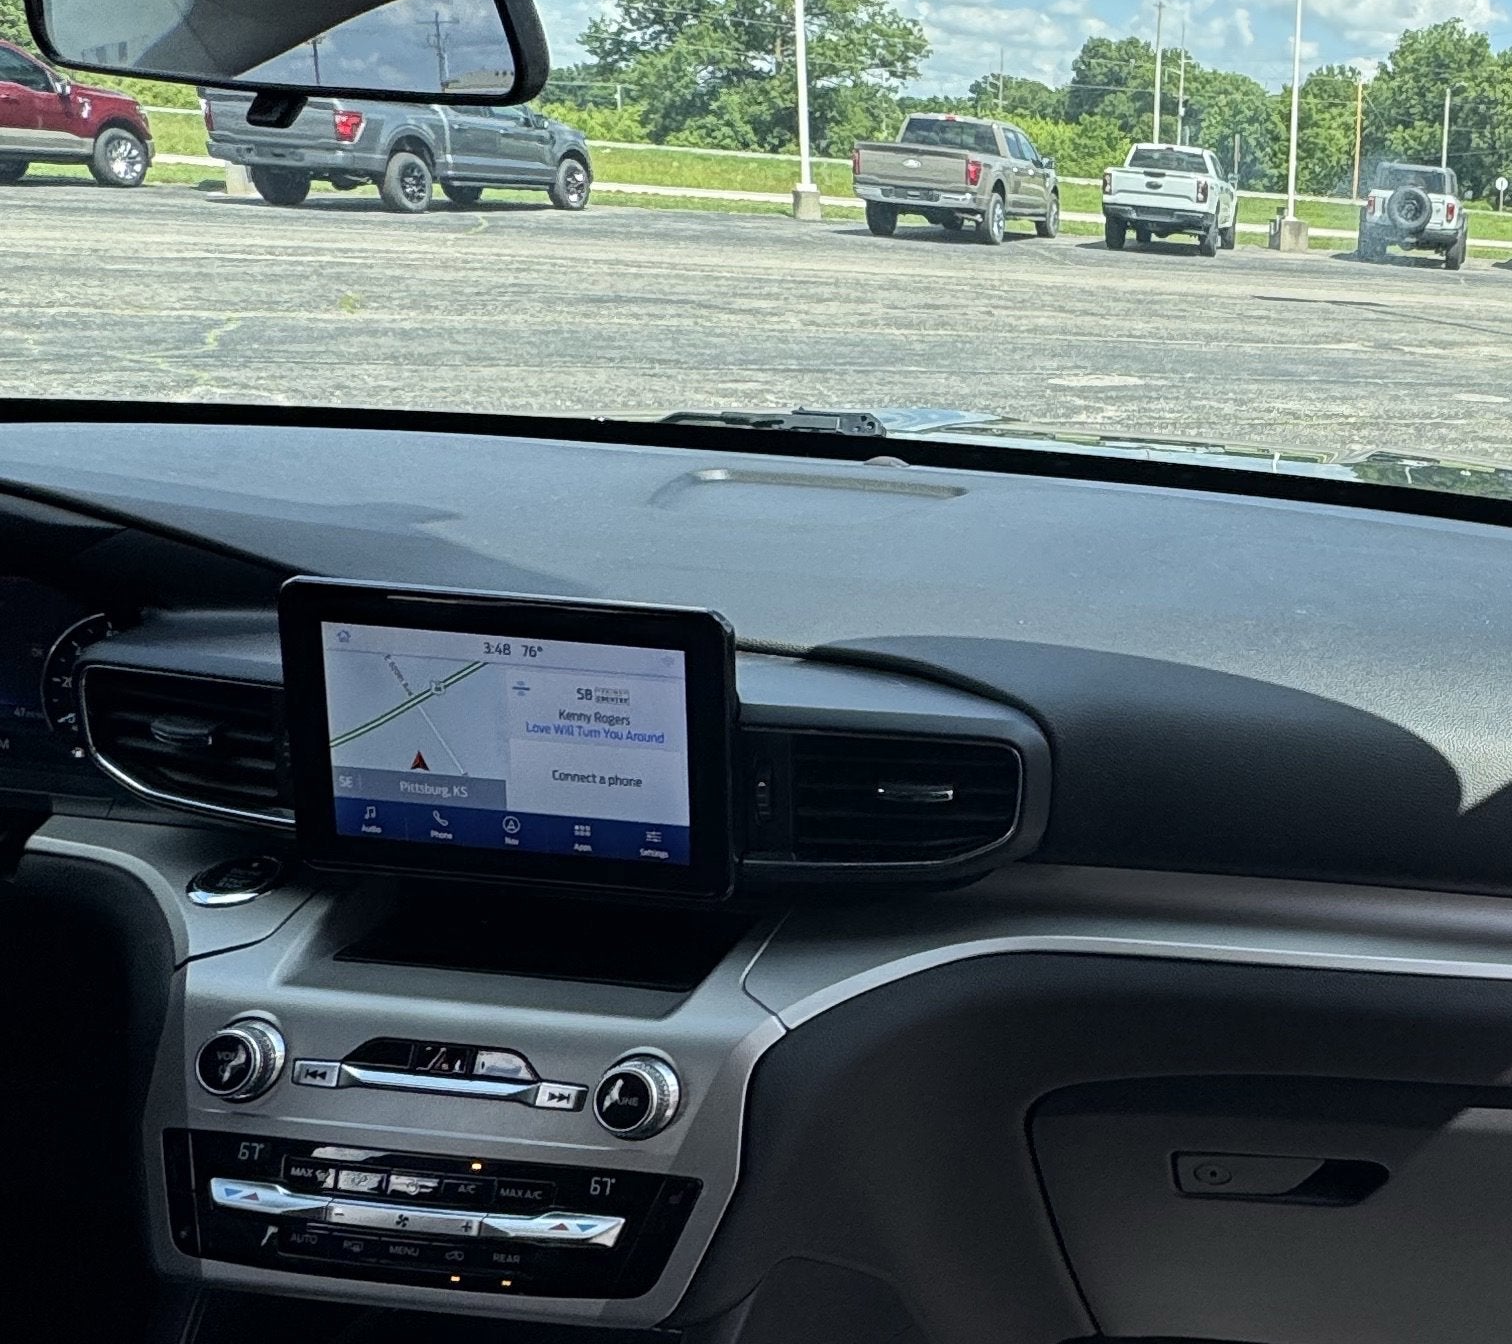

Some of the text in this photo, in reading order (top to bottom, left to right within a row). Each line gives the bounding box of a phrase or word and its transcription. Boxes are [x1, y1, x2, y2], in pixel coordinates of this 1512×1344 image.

[483, 642, 511, 656] 3:48
[558, 709, 630, 726] Kenny Rogers
[526, 721, 665, 744] Love Will Turn You Around
[552, 770, 642, 787] Connect a phone
[400, 780, 451, 798] Pittsburg,
[453, 784, 468, 798] KS
[361, 824, 382, 835] Audio
[430, 830, 453, 840] Phone
[290, 1166, 313, 1178] MAX
[500, 1187, 523, 1198] MAX
[290, 1232, 318, 1245] AUTO
[389, 1245, 419, 1257] MENU
[492, 1252, 521, 1264] REAR
